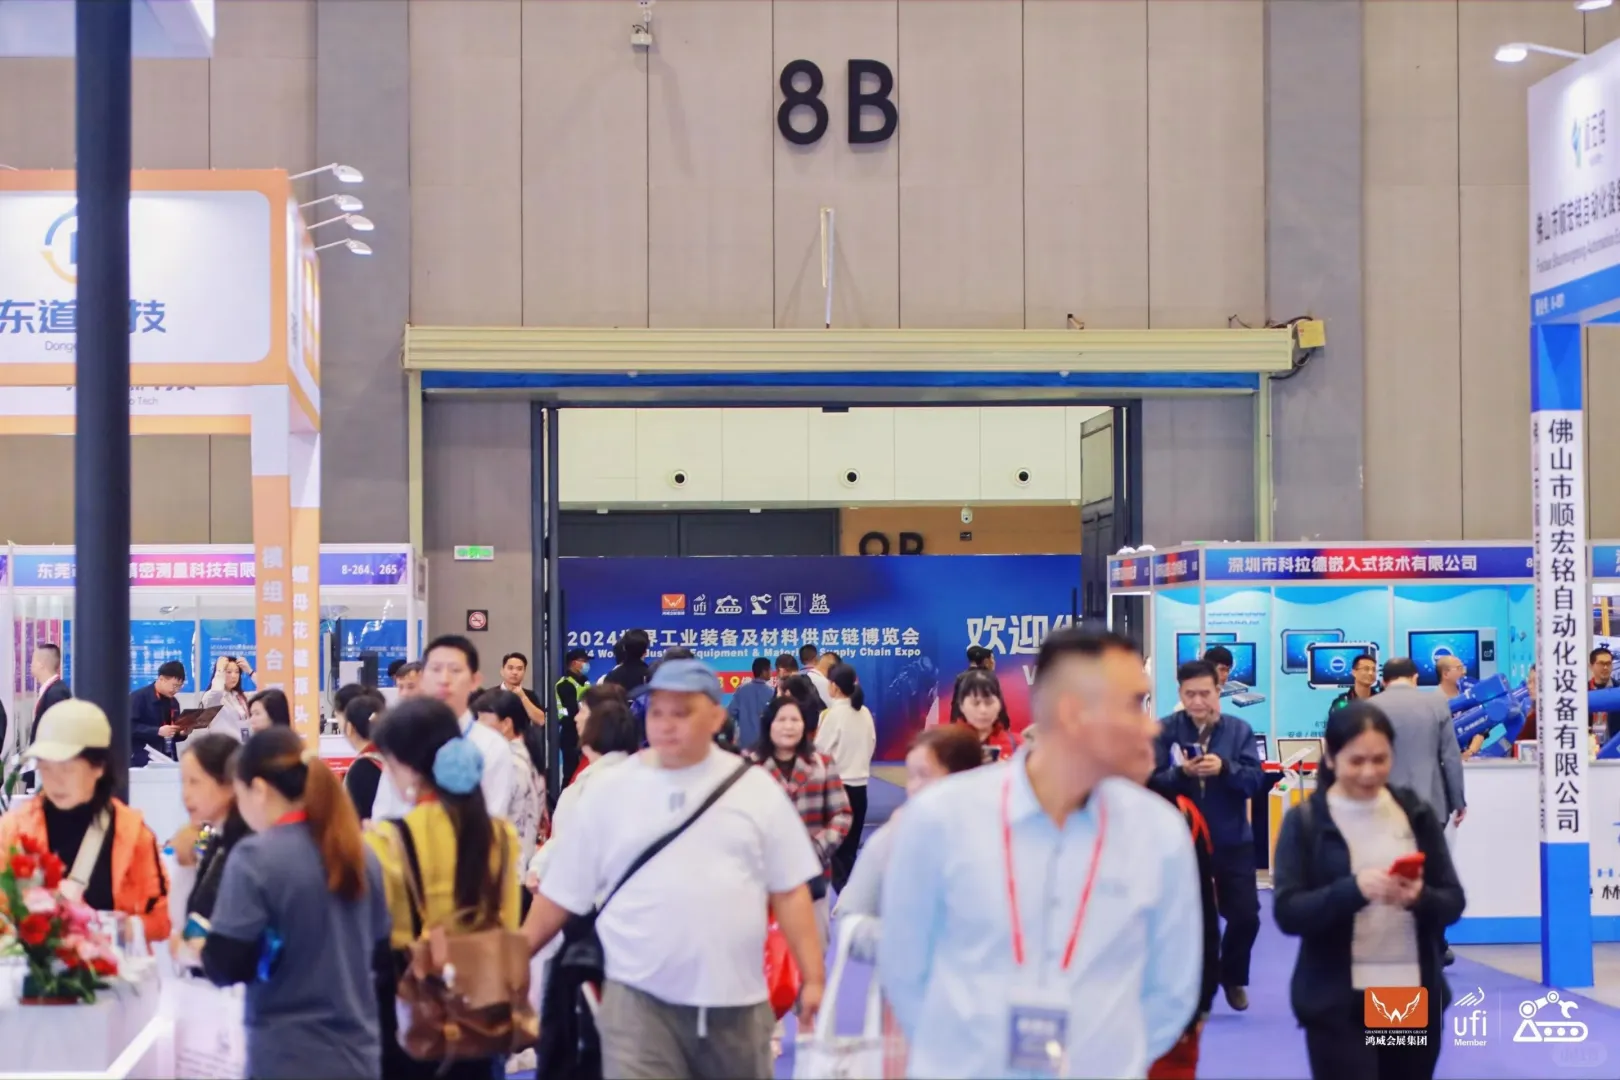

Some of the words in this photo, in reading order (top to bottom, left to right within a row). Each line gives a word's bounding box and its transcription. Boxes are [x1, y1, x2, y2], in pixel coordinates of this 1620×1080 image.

[777, 59, 898, 145] 8B
[1228, 555, 1477, 573] 深圳市科拉德嵌入式技术有限公司
[1548, 418, 1581, 834] 佛山市顺宏铭自动化设备有限公司
[567, 627, 920, 647] 2024界工业装备及材料供应链博览会
[859, 647, 891, 657] Chain
[895, 647, 921, 658] Expo
